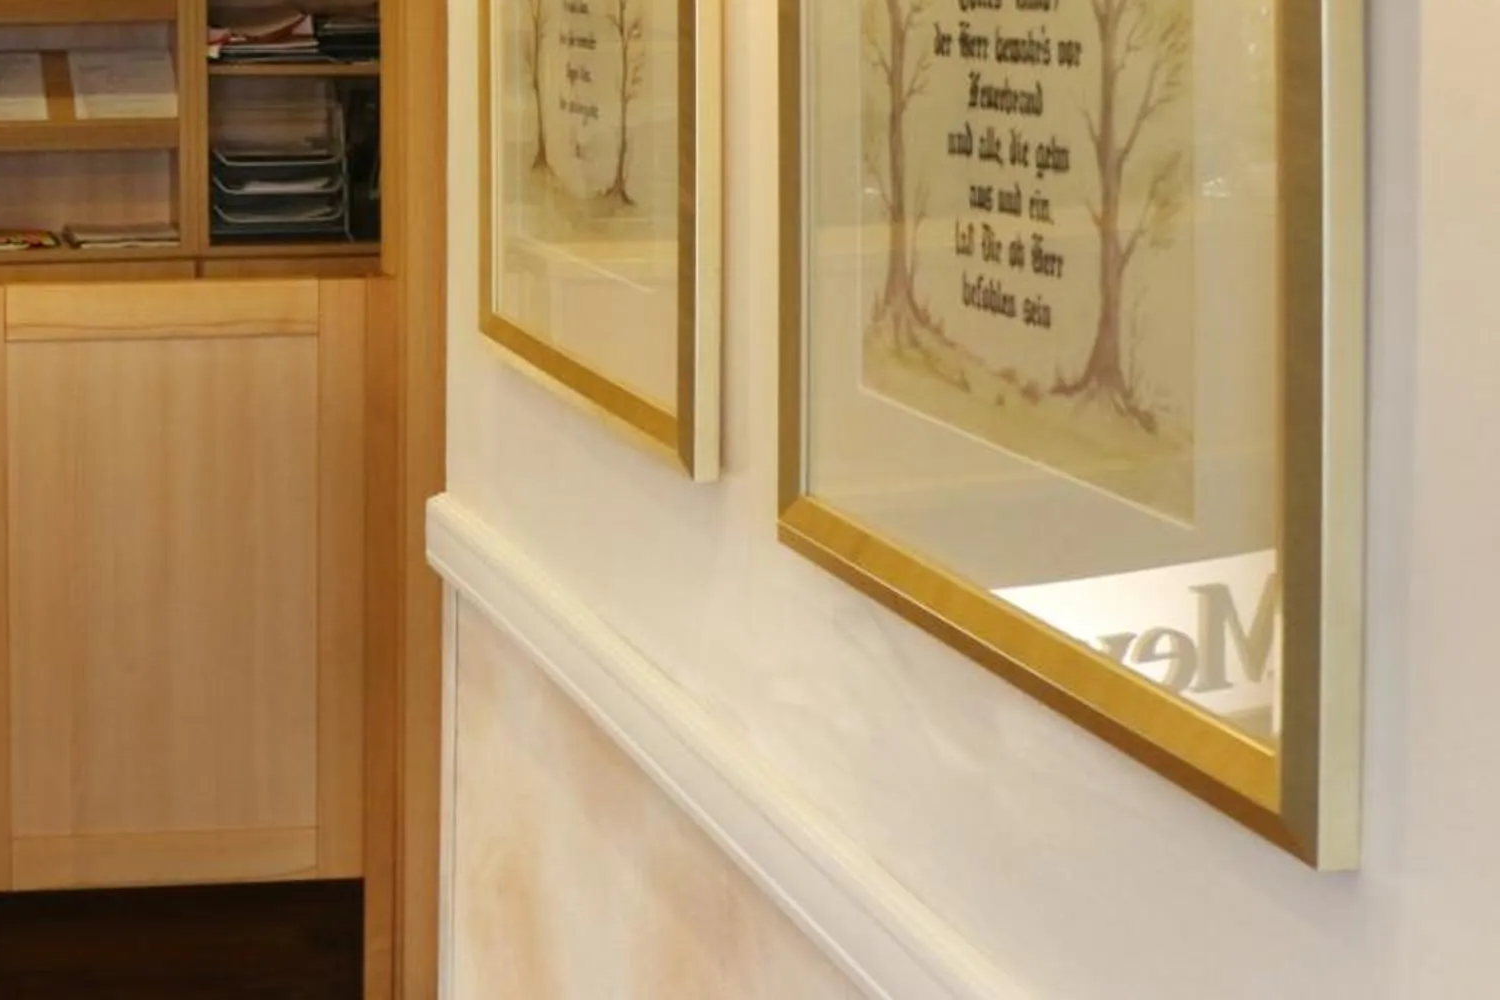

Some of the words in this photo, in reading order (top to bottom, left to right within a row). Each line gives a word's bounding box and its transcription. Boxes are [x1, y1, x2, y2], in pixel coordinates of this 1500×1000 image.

[933, 22, 952, 56] der
[959, 20, 989, 59] Herr
[948, 121, 972, 156] und
[1009, 128, 1028, 167] die
[969, 185, 993, 211] aus
[998, 181, 1022, 215] und
